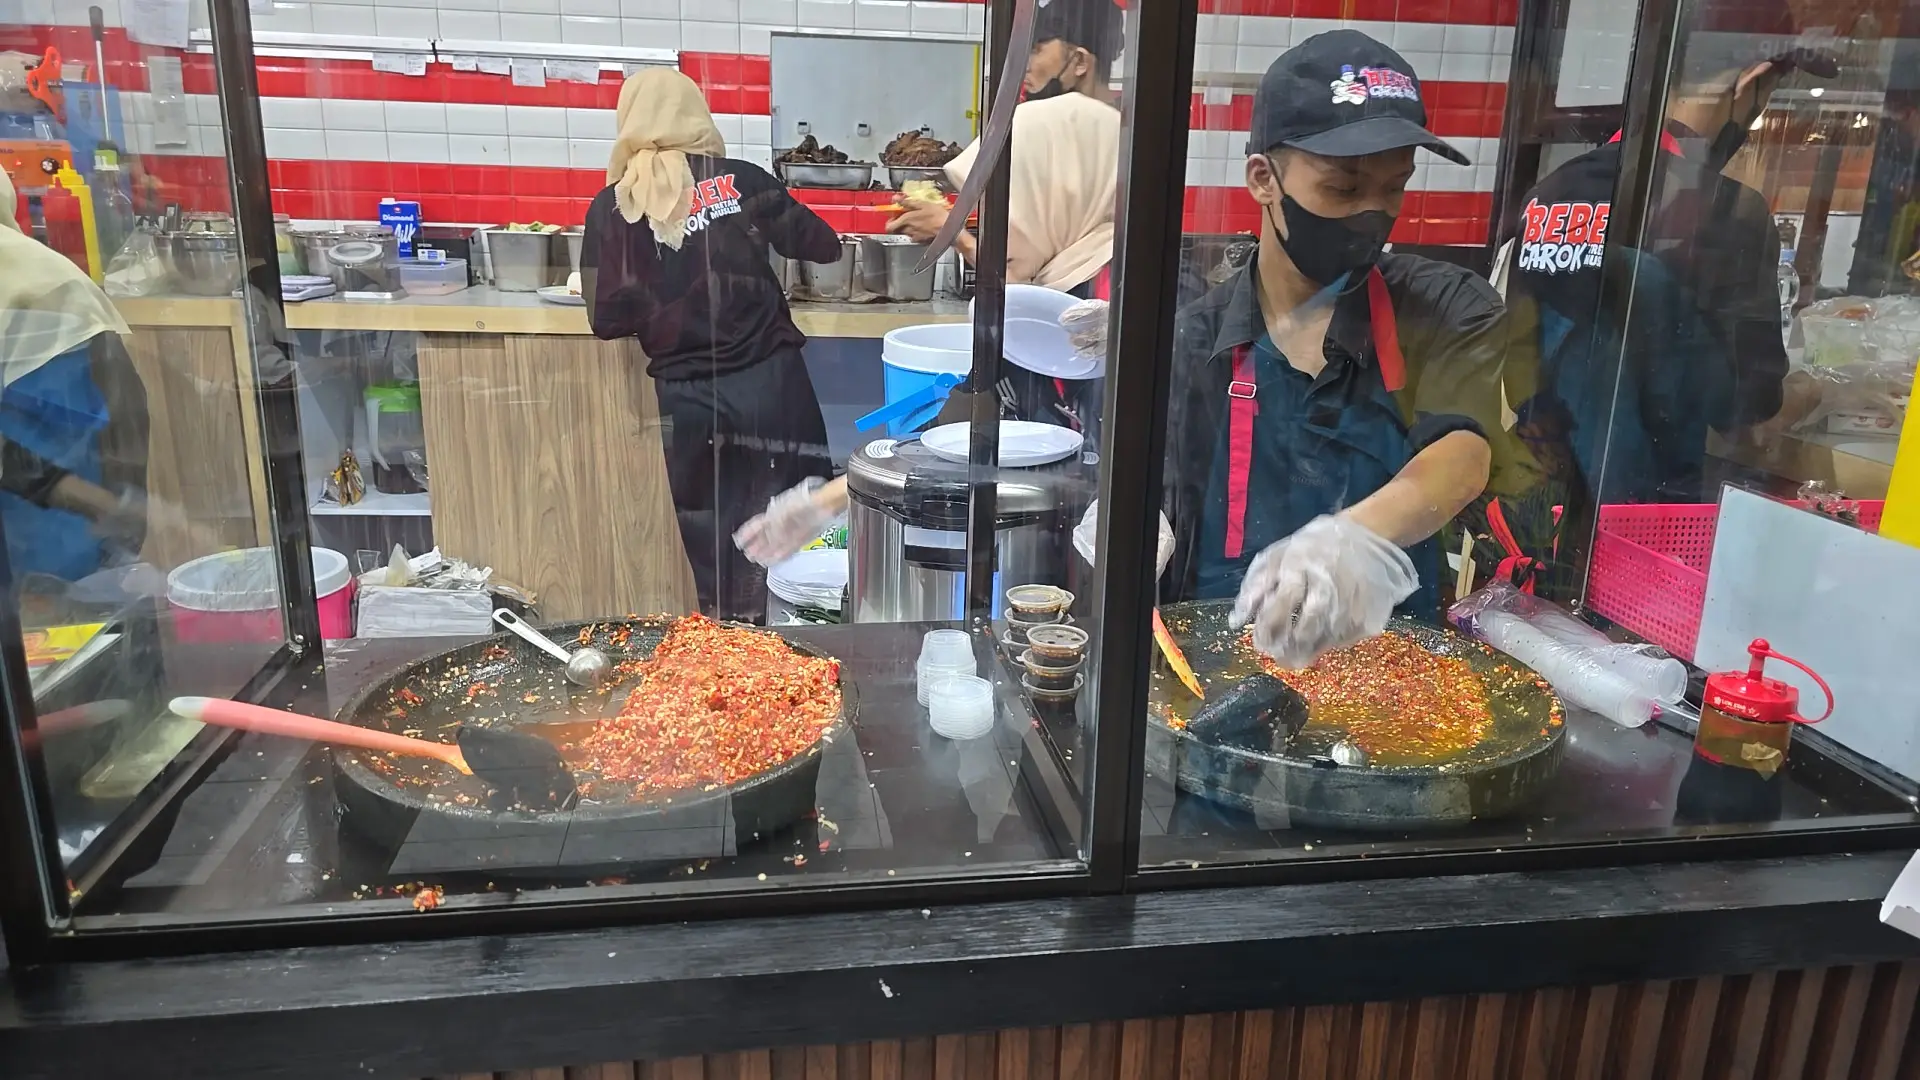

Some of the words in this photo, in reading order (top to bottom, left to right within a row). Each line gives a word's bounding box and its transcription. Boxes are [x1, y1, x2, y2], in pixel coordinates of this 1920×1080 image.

[710, 199, 738, 212] TRETAN
[710, 205, 741, 219] MUSLIM
[1519, 241, 1587, 273] CAROK
